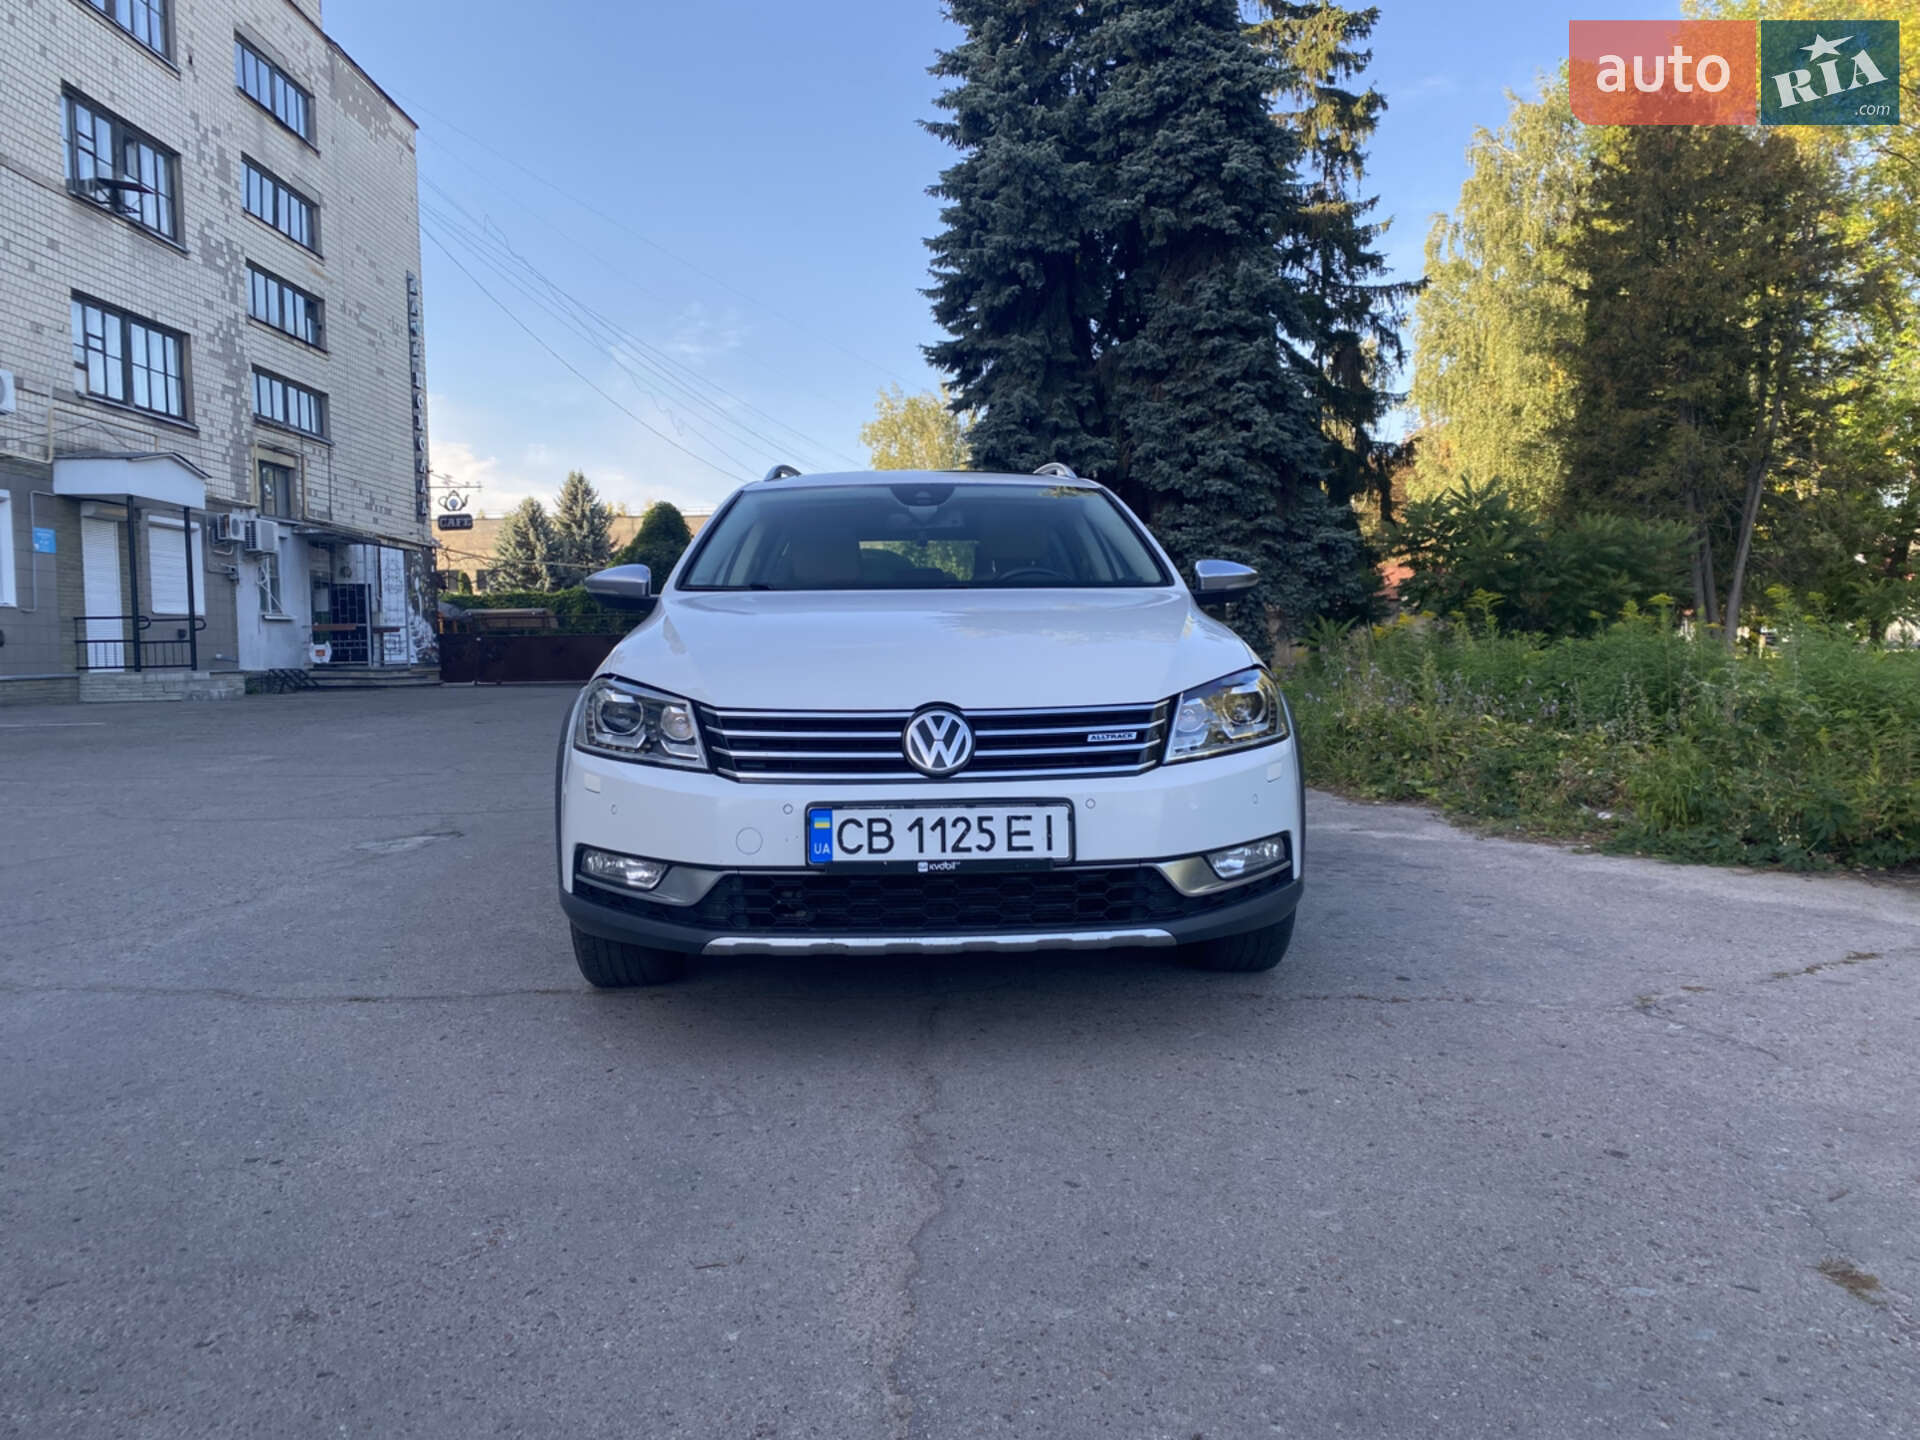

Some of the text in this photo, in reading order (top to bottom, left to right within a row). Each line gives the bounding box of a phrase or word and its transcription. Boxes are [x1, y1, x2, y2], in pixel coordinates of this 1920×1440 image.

[440, 518, 472, 528] CAFE
[1090, 733, 1134, 741] ALLTRACK
[836, 814, 1054, 855] CB 1125 EI
[813, 843, 831, 855] UA
